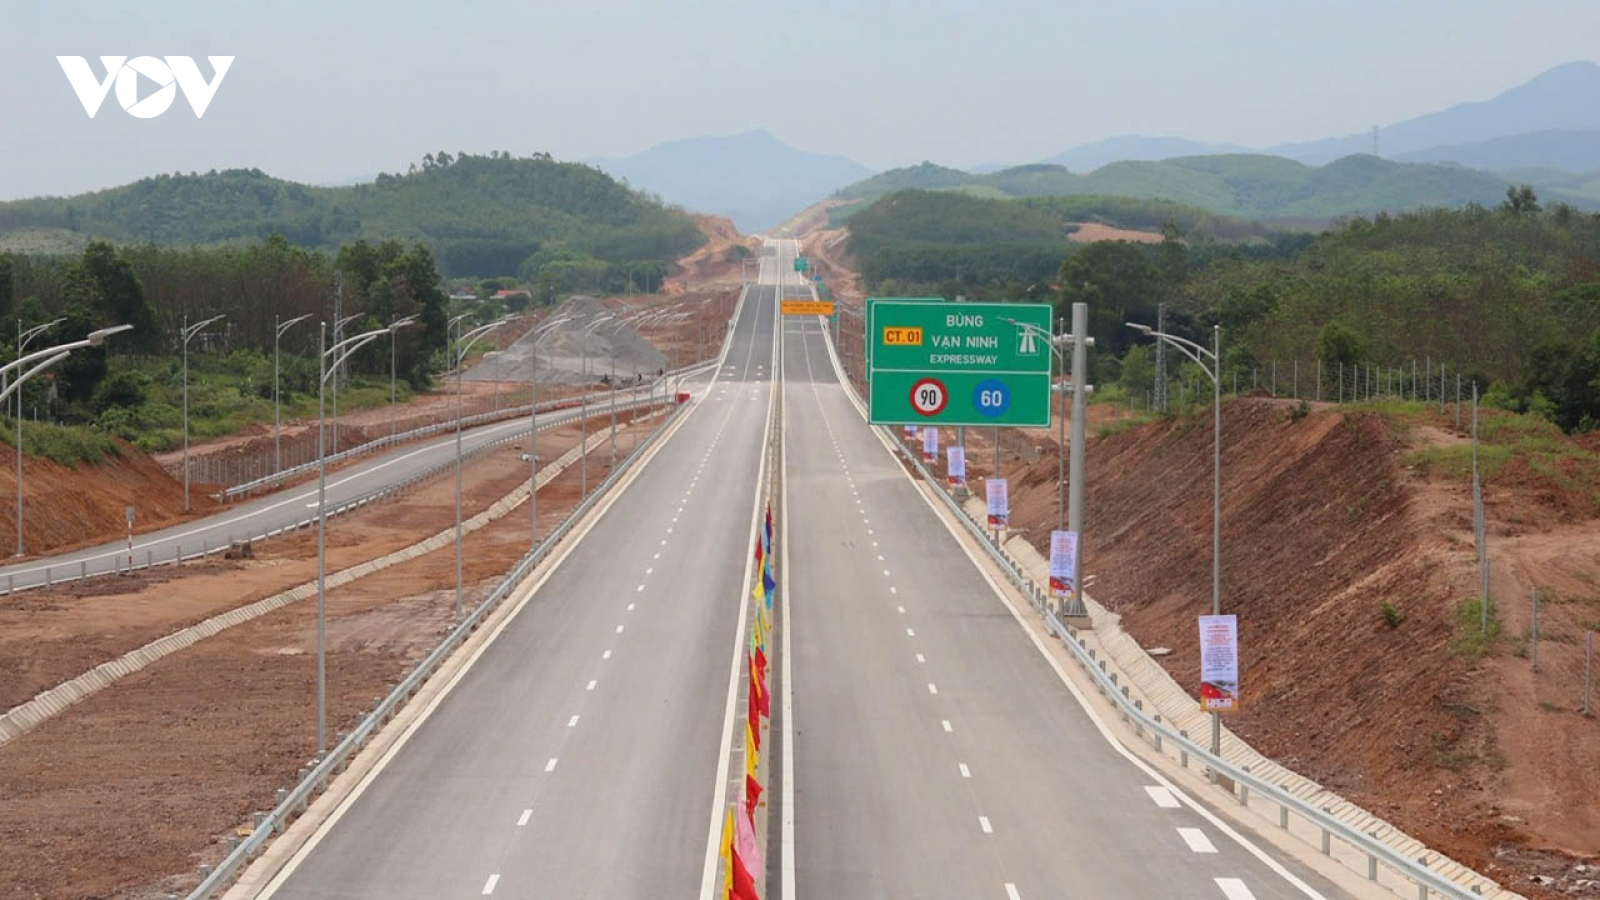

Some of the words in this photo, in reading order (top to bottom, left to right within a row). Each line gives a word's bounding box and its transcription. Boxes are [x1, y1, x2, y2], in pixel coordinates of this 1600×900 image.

[946, 312, 984, 328] BÙNG
[931, 335, 961, 350] VẠN
[966, 336, 998, 349] NINH
[929, 354, 998, 365] EXPRESSWAY
[920, 389, 937, 406] 90
[980, 390, 1003, 407] 60
